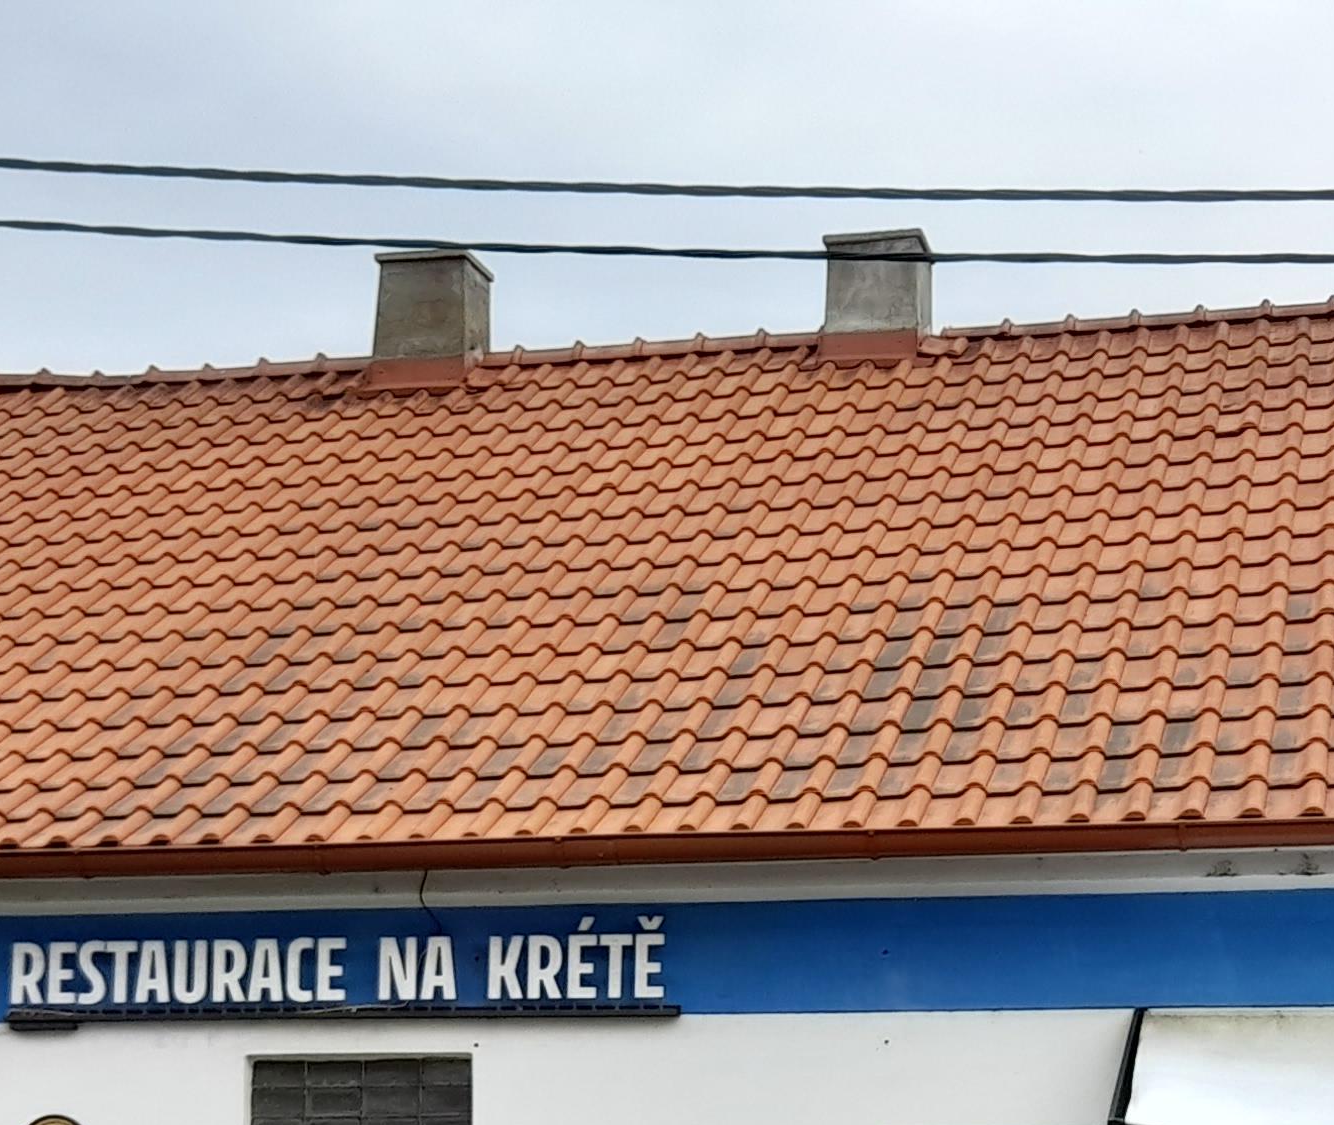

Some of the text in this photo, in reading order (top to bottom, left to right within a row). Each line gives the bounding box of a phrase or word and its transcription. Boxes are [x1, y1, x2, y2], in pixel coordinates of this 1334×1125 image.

[10, 915, 666, 1006] RESTAURACE NA KRÉTĚ
